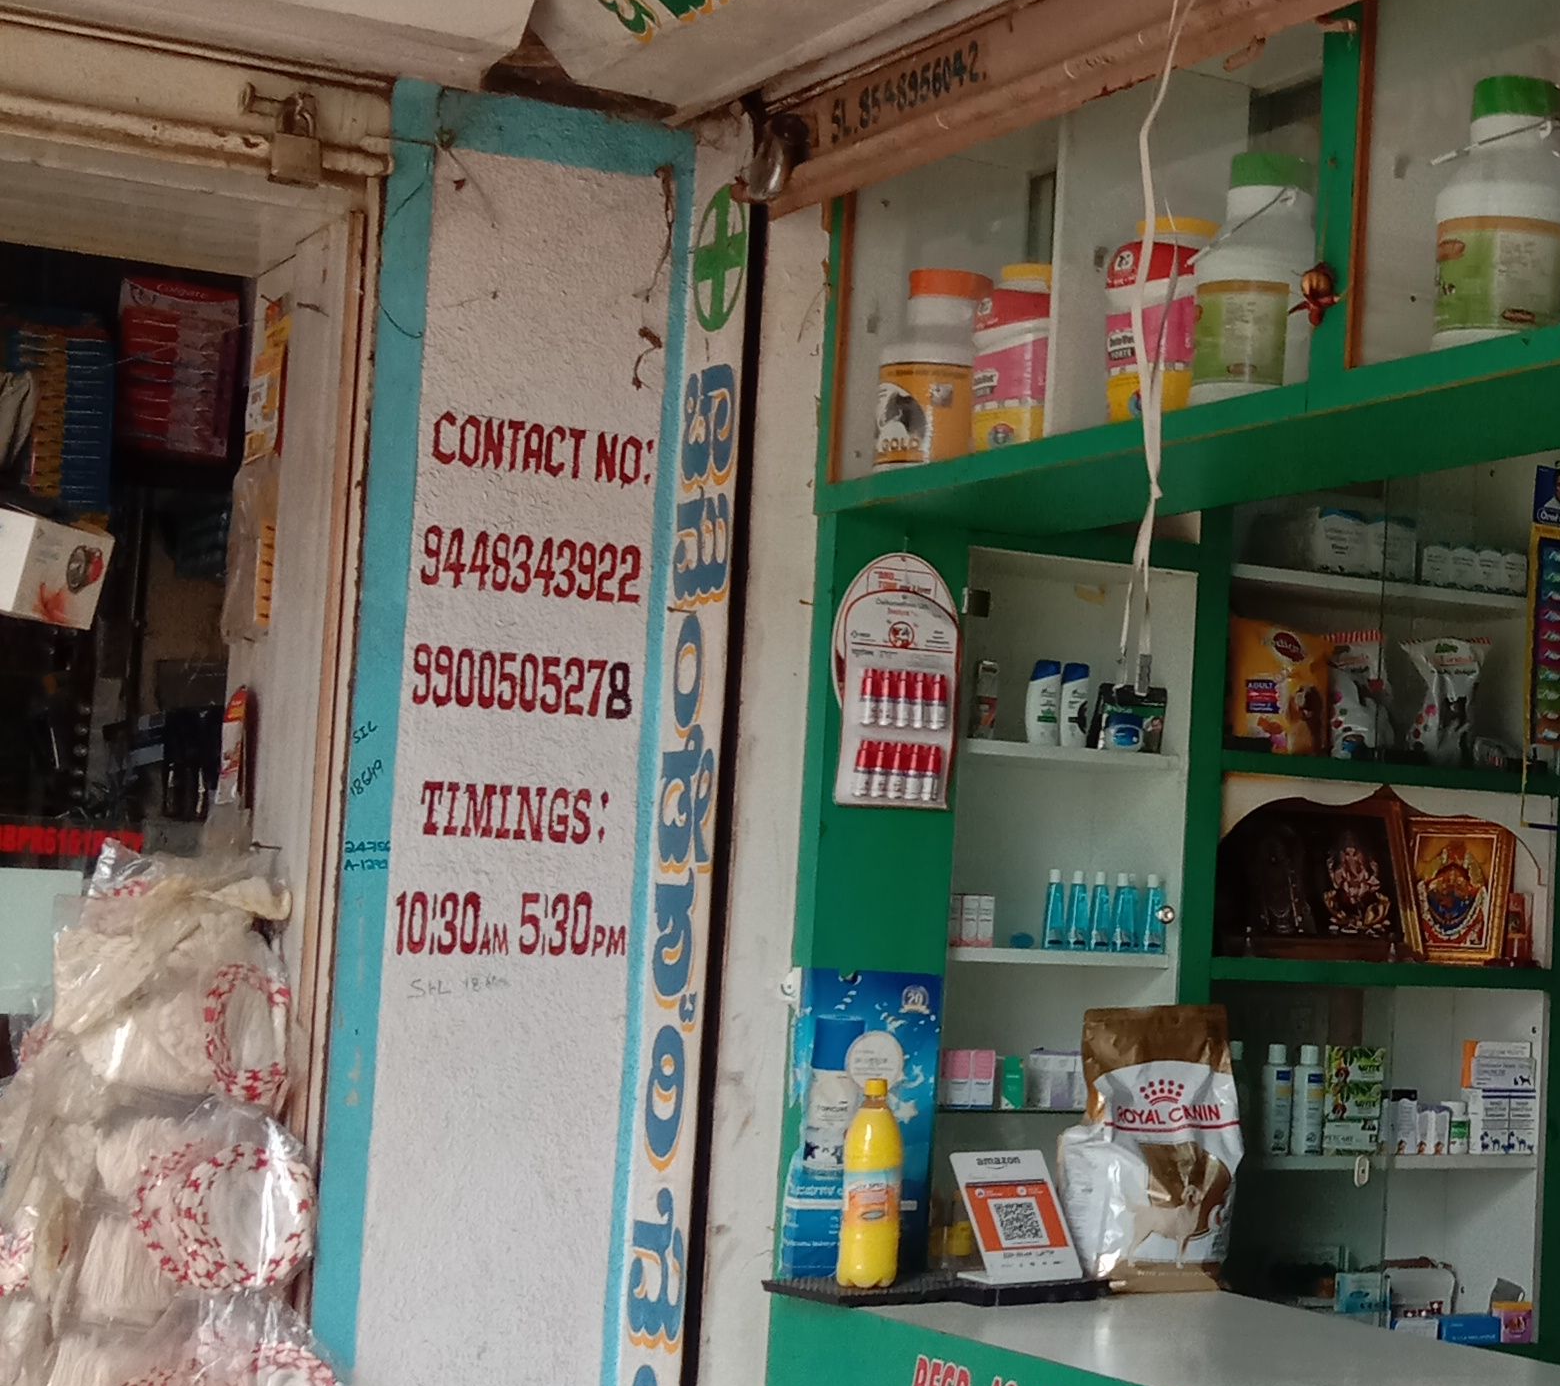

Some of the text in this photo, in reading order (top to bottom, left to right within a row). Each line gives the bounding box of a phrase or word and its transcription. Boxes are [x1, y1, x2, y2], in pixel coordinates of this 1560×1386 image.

[431, 409, 586, 481] CONTACT
[419, 524, 642, 604] 9448343922
[411, 642, 634, 720] 9900505278
[1116, 1103, 1222, 1125] ROYAL CANIN
[975, 1155, 1022, 1167] amazon
